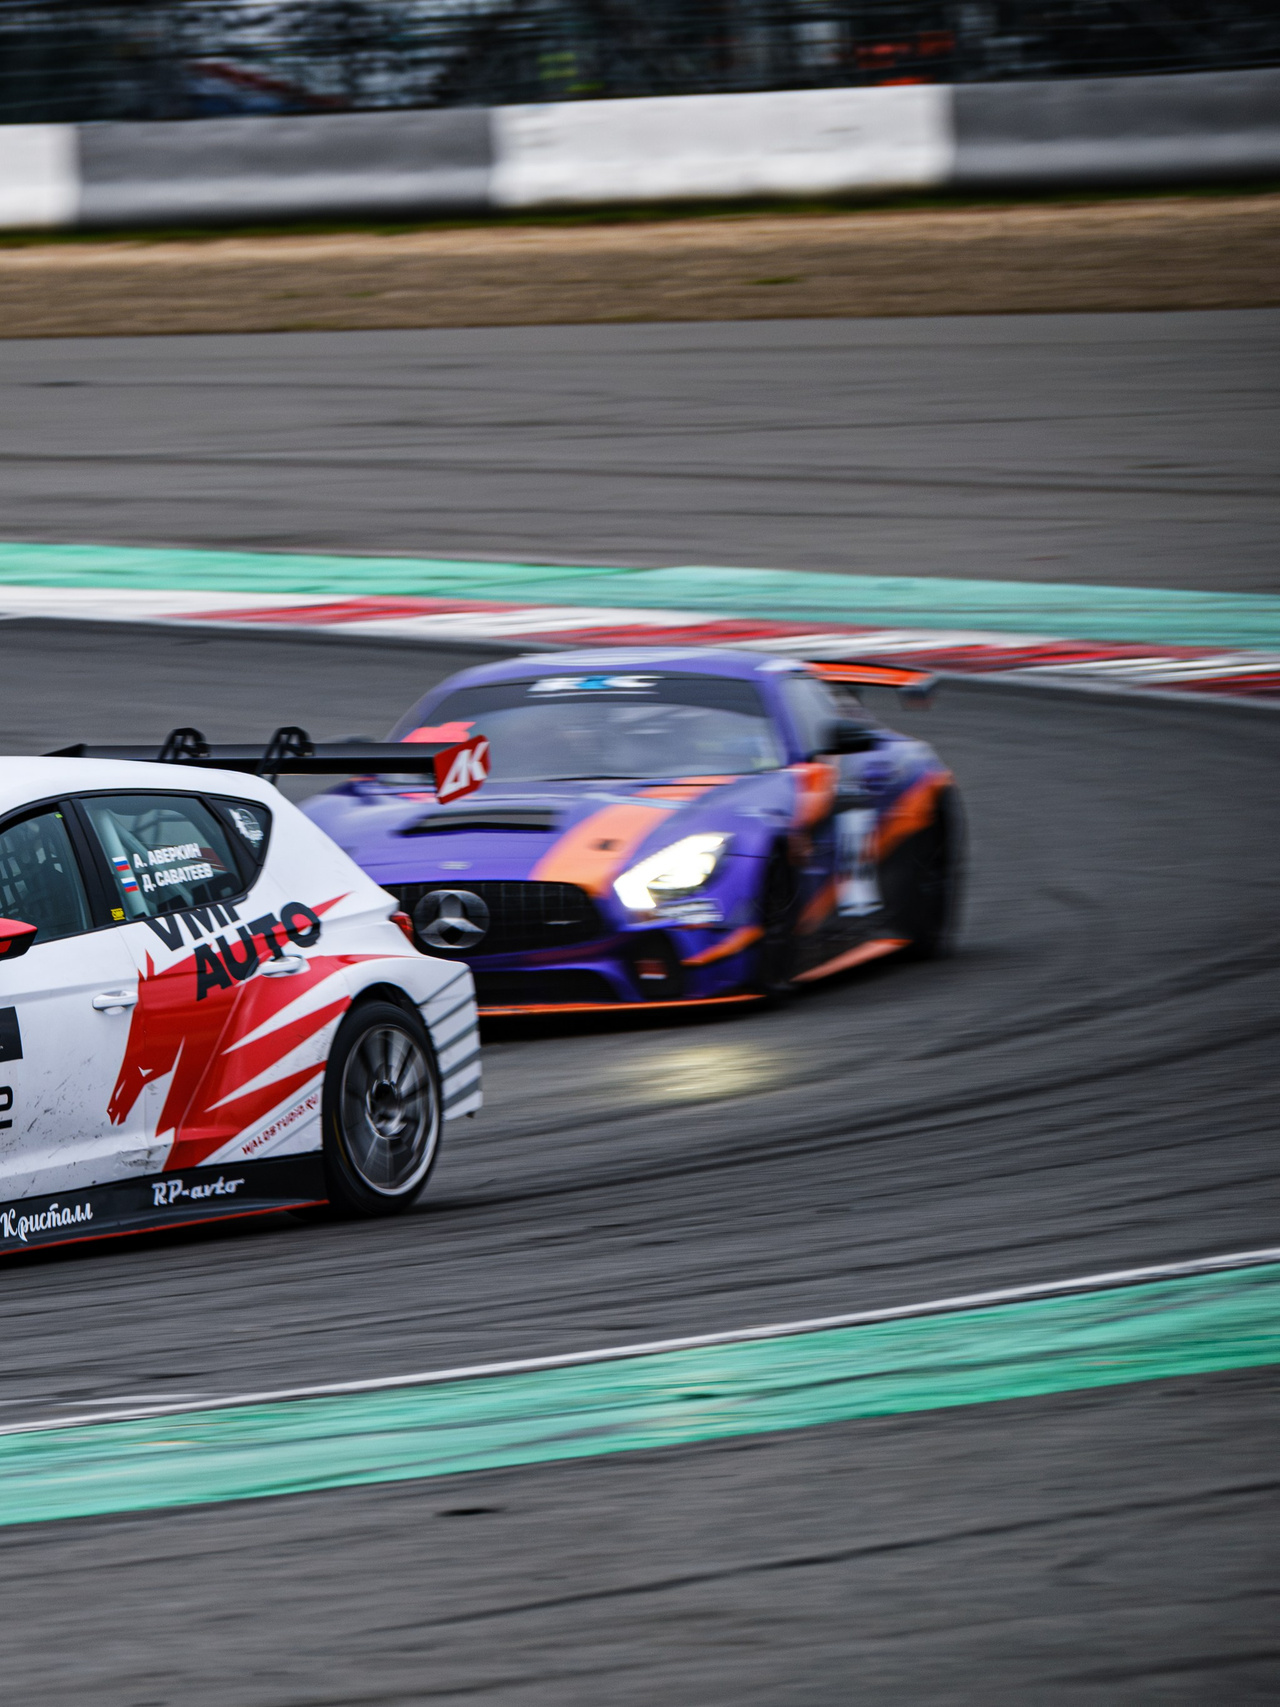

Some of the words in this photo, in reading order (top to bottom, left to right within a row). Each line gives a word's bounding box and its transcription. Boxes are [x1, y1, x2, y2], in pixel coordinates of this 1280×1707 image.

[133, 853, 148, 868] А.
[147, 843, 202, 866] АВЕРКИН
[141, 874, 157, 892] Д.
[154, 862, 214, 887] САВАТЕЕВ
[193, 902, 322, 1002] AUTO
[151, 1176, 246, 1206] RP-avto
[0, 1202, 94, 1243] Кристалл
